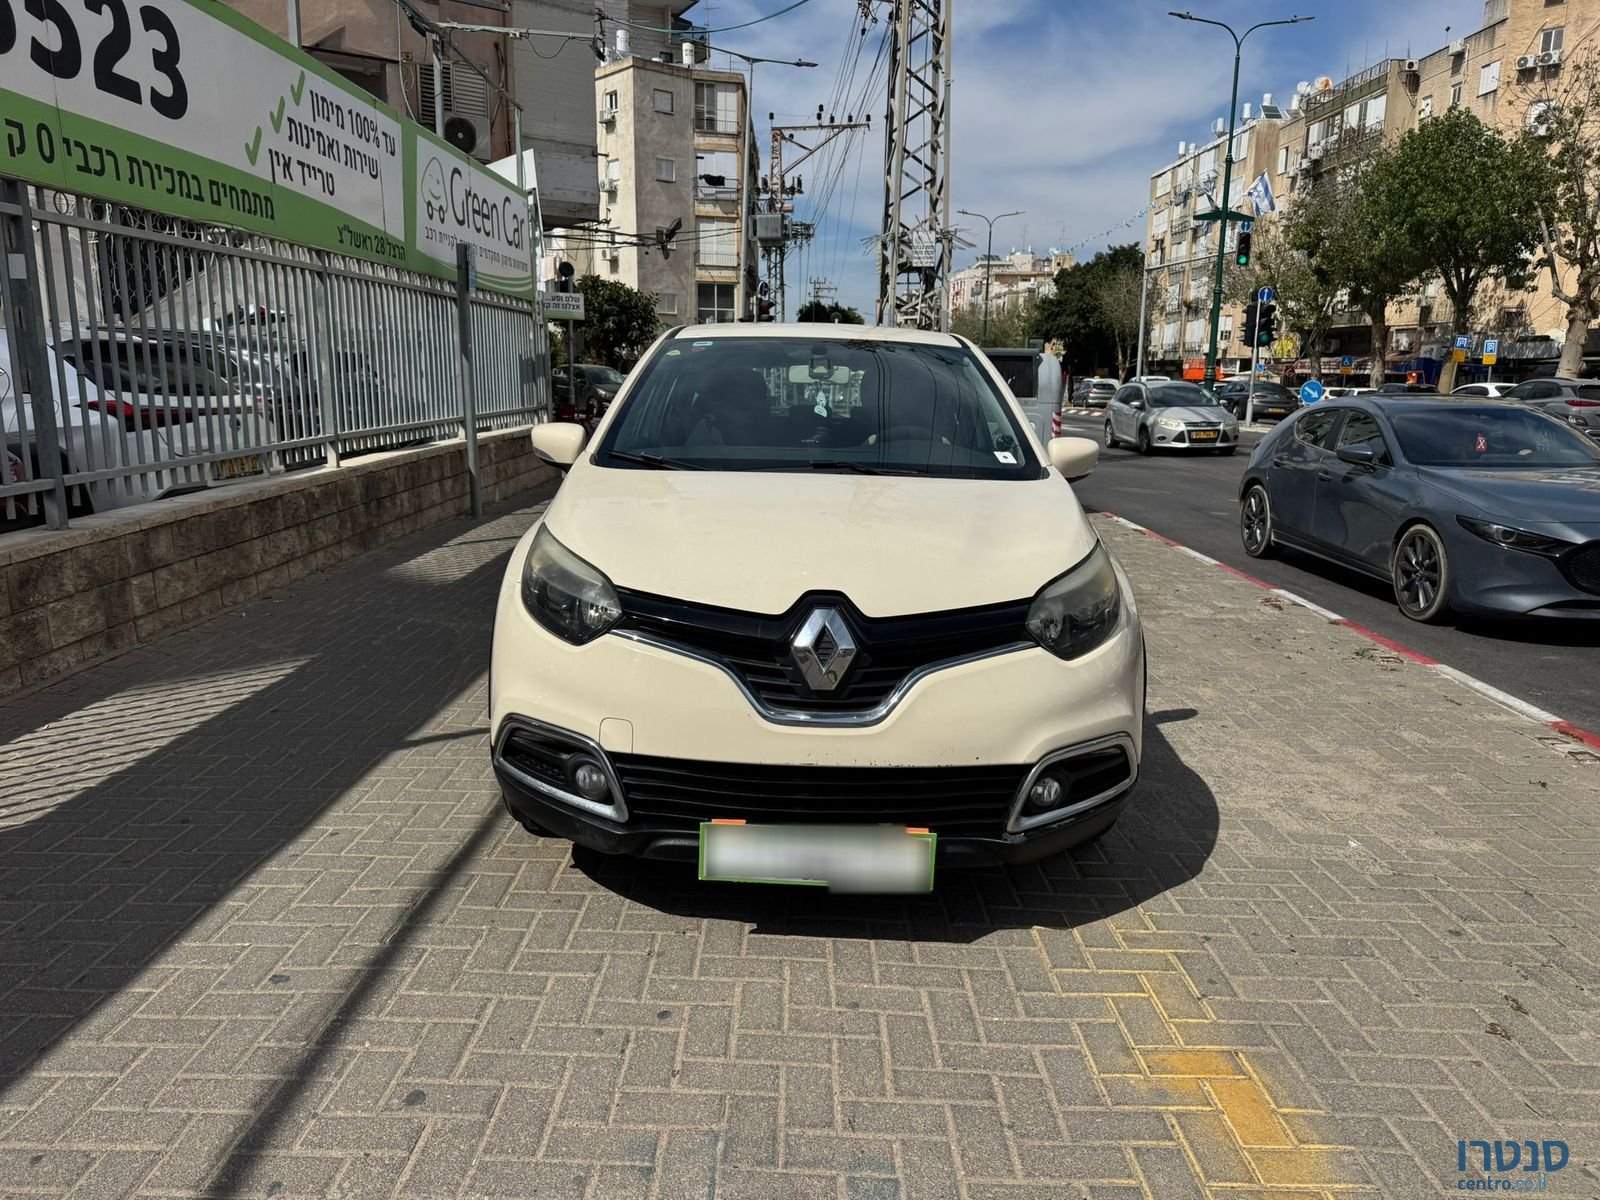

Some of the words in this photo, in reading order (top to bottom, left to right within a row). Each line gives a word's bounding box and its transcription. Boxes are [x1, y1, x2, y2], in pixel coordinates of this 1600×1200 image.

[0, 0, 188, 120] 523
[310, 89, 345, 130] מימון
[348, 109, 380, 149] 100%
[36, 122, 55, 164] 0
[62, 136, 121, 182] רכבי
[287, 116, 341, 163] ואמינות
[382, 131, 396, 157] עד
[126, 155, 205, 203] במכירת
[268, 148, 293, 184] אין
[297, 159, 335, 196] טרייד
[344, 143, 379, 180] שירות
[208, 179, 275, 220] מתמחים
[450, 167, 500, 241] Green
[503, 196, 525, 251] Car
[374, 235, 386, 256] 28
[387, 237, 406, 261] הרצל
[425, 226, 438, 242] רכב
